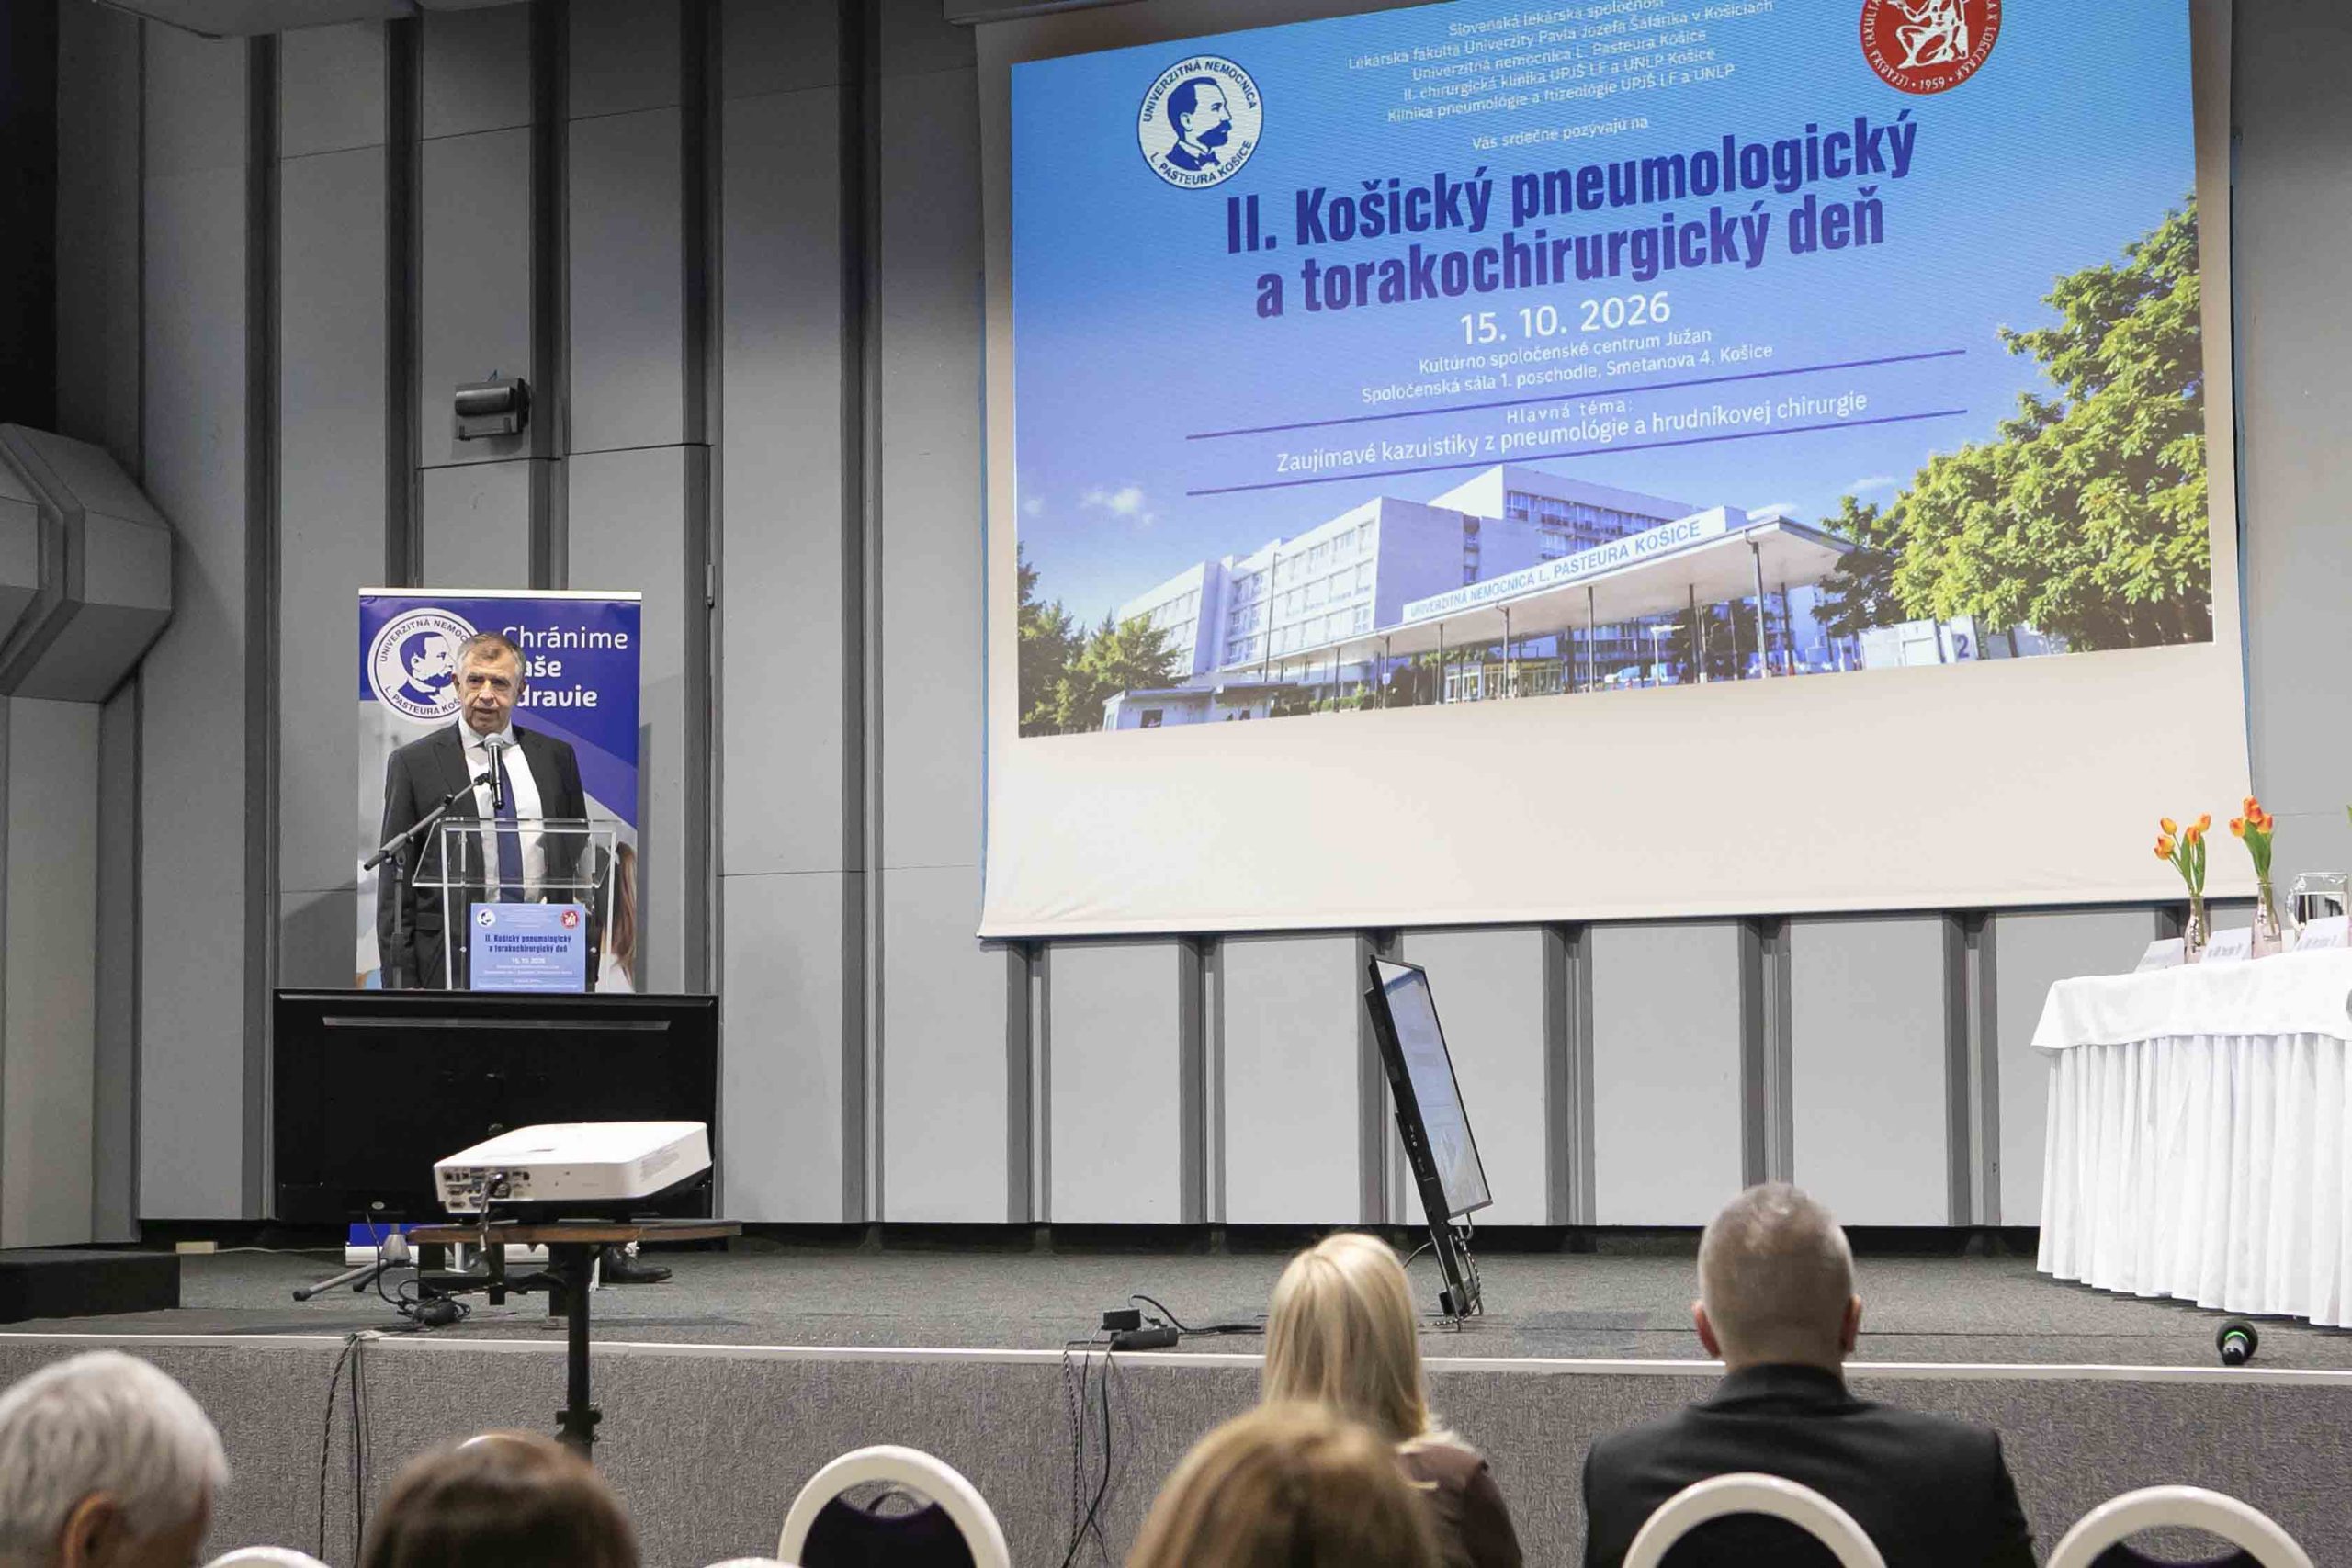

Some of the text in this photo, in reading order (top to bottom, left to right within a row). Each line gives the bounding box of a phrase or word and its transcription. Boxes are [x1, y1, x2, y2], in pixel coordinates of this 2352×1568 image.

[1464, 33, 1534, 54] Univerzity
[1691, 11, 1701, 21] v
[1592, 38, 1655, 56] Pasteura
[1143, 60, 1258, 122] UNIVERZITNÁ NEMOCNICA
[1387, 106, 1433, 123] Klinika
[1681, 73, 1690, 84] a
[1694, 64, 1736, 81] UNLP
[1500, 71, 1546, 87] klinika
[1919, 76, 1945, 90] 1959
[1501, 128, 1559, 145] srdečne
[1631, 118, 1649, 130] na
[1159, 162, 1216, 185] PASTEURA
[1227, 109, 1917, 254] II. Košický pneumologický
[1256, 186, 1883, 319] a torakochirurgický deň
[1461, 291, 1671, 345] 15. 10. 2026
[1362, 378, 1460, 405] Spoločenská
[1464, 375, 1496, 392] sála
[1499, 373, 1512, 388] 1.
[1606, 354, 1695, 376] Smetanova
[1720, 344, 1773, 363] Košice
[1419, 355, 1486, 374] Kultúrno
[1489, 341, 1589, 368] spoločenské
[1593, 336, 1660, 354] centrum
[1277, 390, 1868, 474] Zaujímavé kazuistiky z pneumológie a hrudníkovej chirurgie
[1507, 402, 1570, 424] Hlavná
[1554, 545, 1629, 578] PASTEURA
[1635, 520, 1702, 554] KOŠICE
[380, 618, 430, 662] UNIVERZITNÁ
[1956, 634, 1970, 659] 2
[392, 694, 441, 715] PASTEURA
[516, 684, 598, 707] dravie
